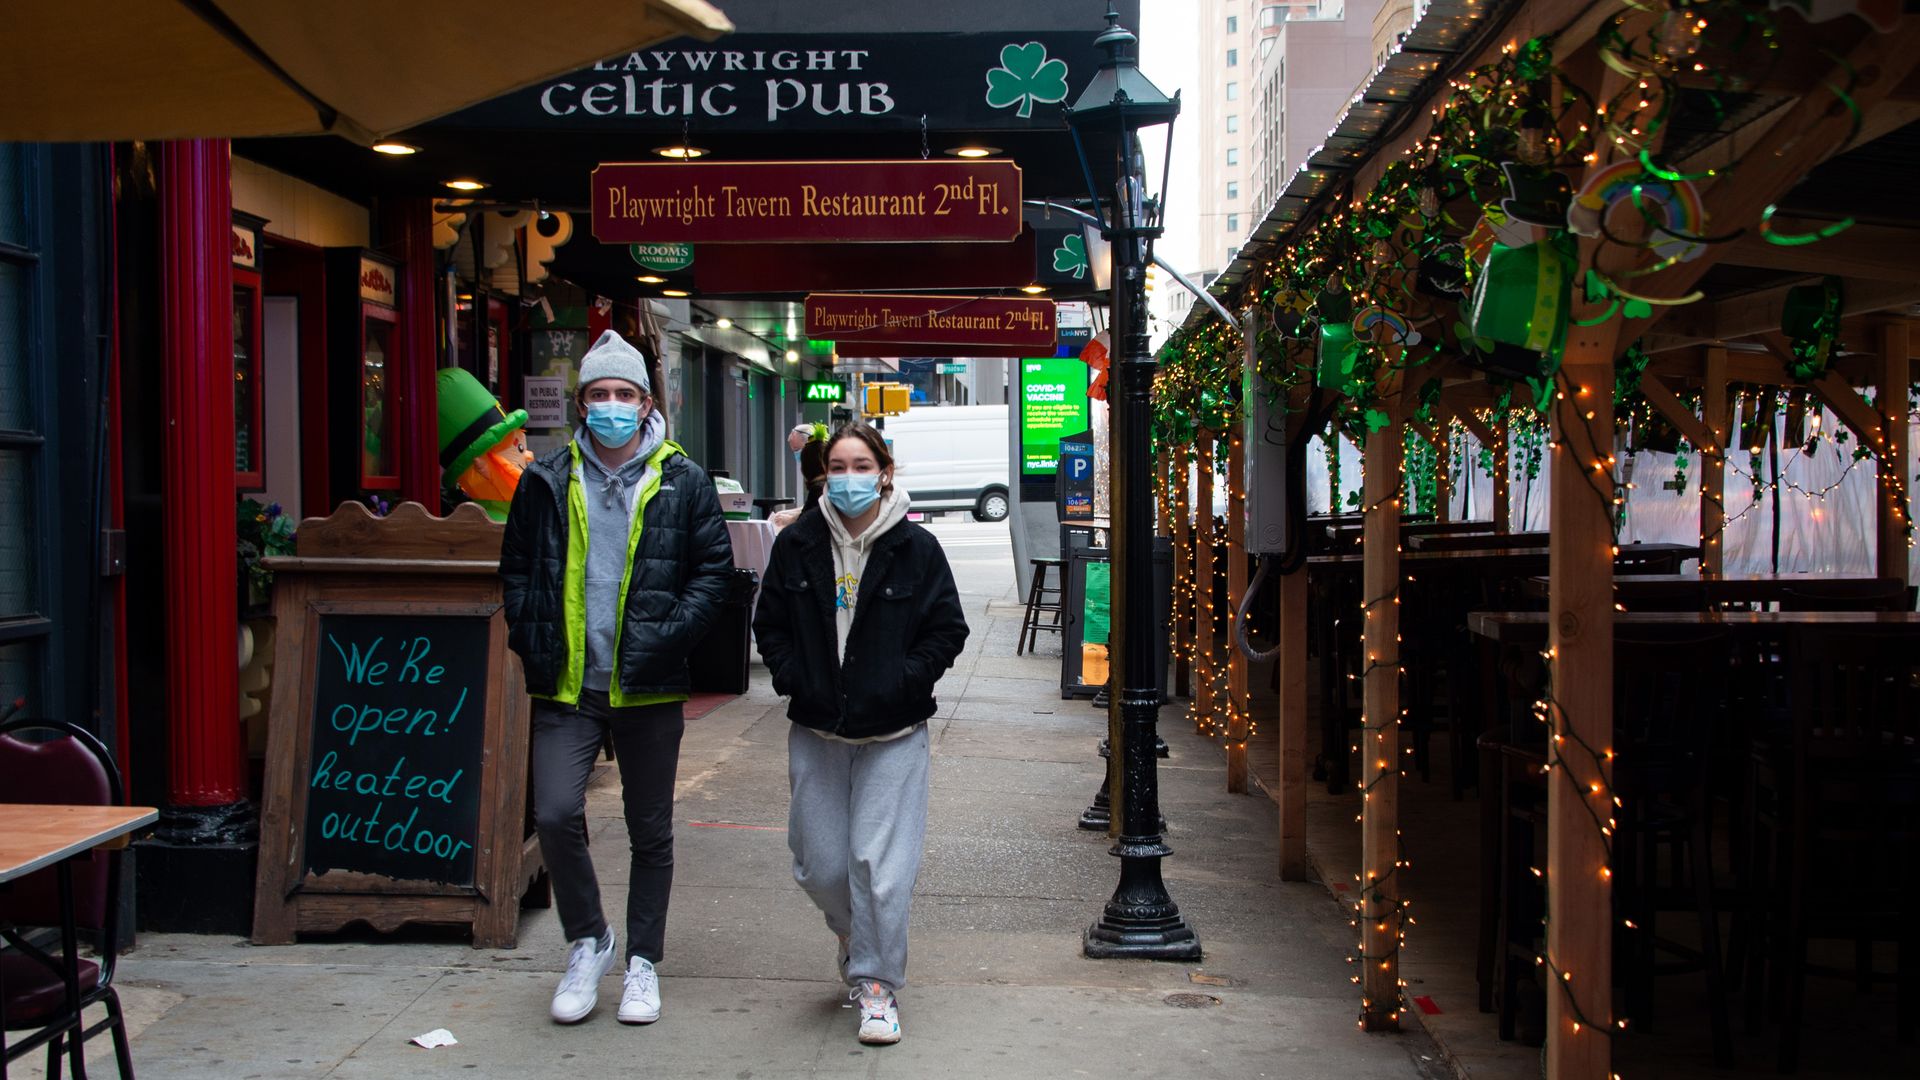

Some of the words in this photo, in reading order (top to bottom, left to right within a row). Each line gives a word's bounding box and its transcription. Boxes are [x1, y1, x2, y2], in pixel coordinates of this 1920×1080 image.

[592, 50, 868, 71] LAYWRIGHT
[608, 185, 715, 226] Playwright
[722, 186, 791, 217] Tavern
[801, 185, 926, 216] Restaurant
[933, 176, 974, 215] 2nd
[978, 183, 1009, 215] Fl.
[638, 246, 689, 256] ROOMS
[640, 256, 686, 264] AVAILABLE
[815, 306, 877, 330] Playwright
[882, 308, 922, 328] Tavern
[928, 309, 1000, 330] Restaurant
[1005, 307, 1029, 330] 2nd
[1031, 311, 1049, 331] Fl.
[808, 384, 840, 399] ATM
[1026, 384, 1066, 392] COVID-19
[1026, 393, 1064, 401] VACCINE
[1074, 458, 1087, 478] P
[332, 687, 468, 745] open!
[311, 751, 464, 803] heated
[322, 801, 473, 860] outdoor
